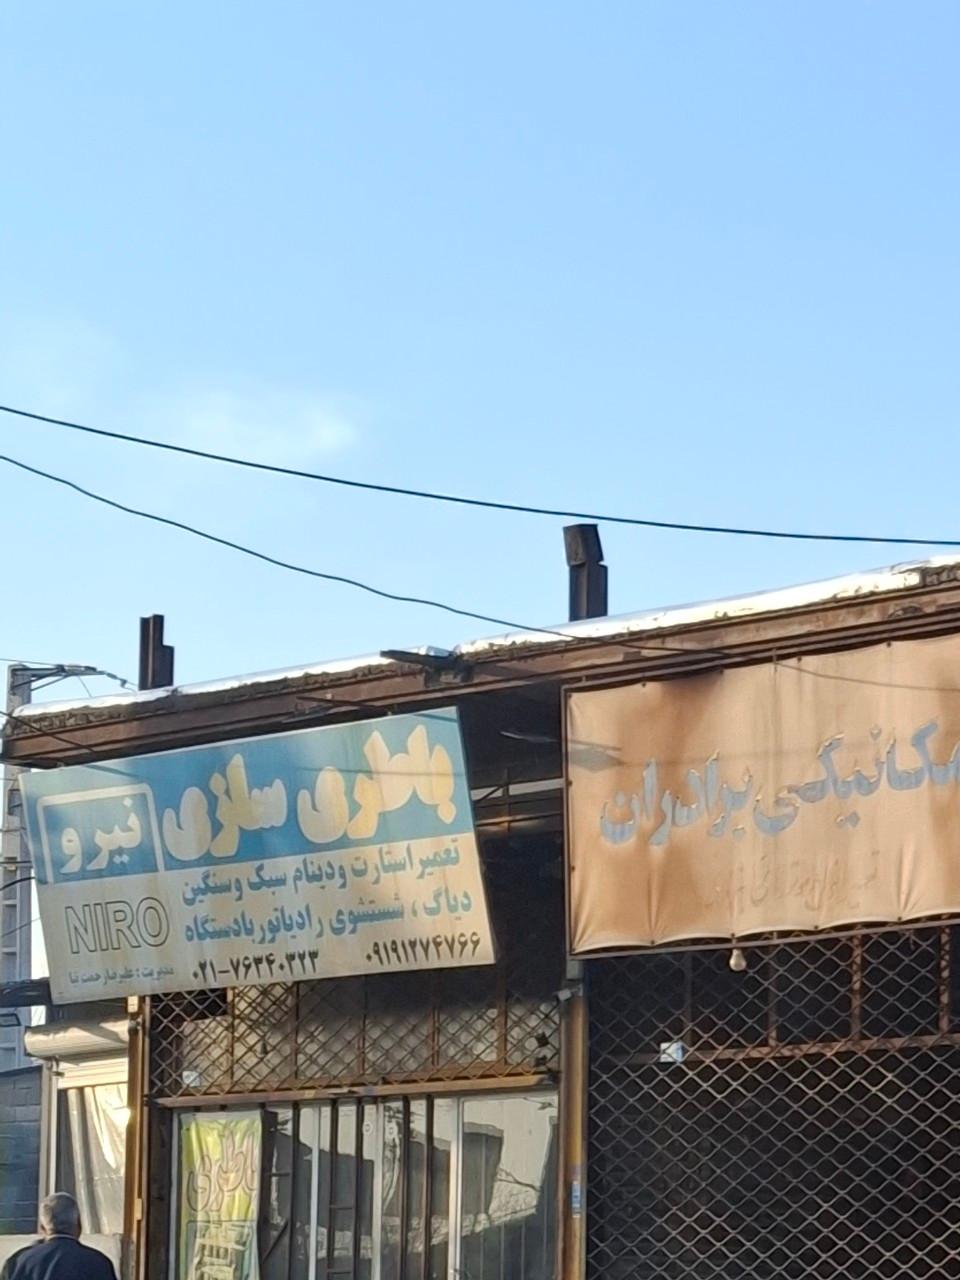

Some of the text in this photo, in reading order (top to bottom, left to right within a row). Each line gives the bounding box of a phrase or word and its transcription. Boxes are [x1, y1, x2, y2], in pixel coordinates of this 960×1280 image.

[162, 724, 457, 860] باطری سازی
[600, 748, 755, 848] برادران
[60, 797, 142, 873] نیرو
[416, 838, 461, 880] تعمیر
[247, 863, 287, 896] سبک
[351, 843, 413, 885] استارت
[64, 896, 170, 954] NIRO
[365, 931, 480, 963] ۰۹۱۹۱۲۷۴۷۶۶
